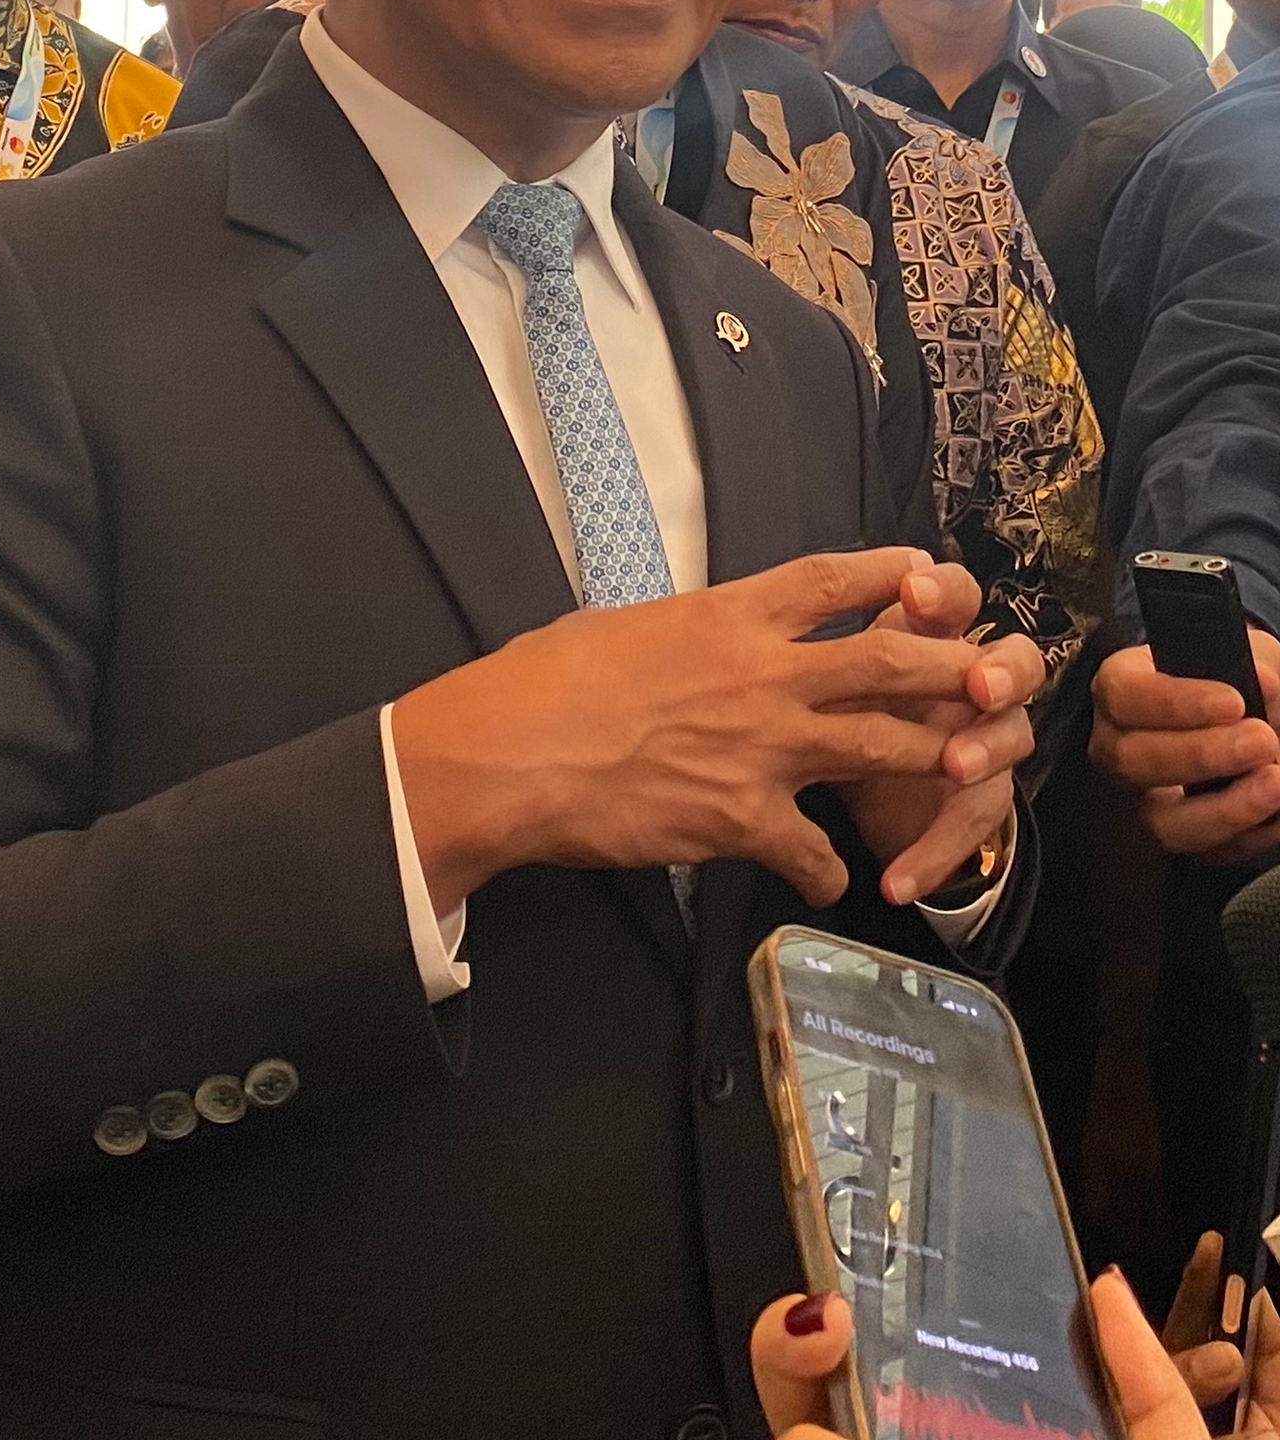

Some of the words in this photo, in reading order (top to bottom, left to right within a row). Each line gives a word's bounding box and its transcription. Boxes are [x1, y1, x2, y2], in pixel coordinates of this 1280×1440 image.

[802, 1010, 827, 1033] All
[831, 1018, 936, 1065] Recordings
[915, 1328, 946, 1350] New
[946, 1335, 1011, 1368] Recording
